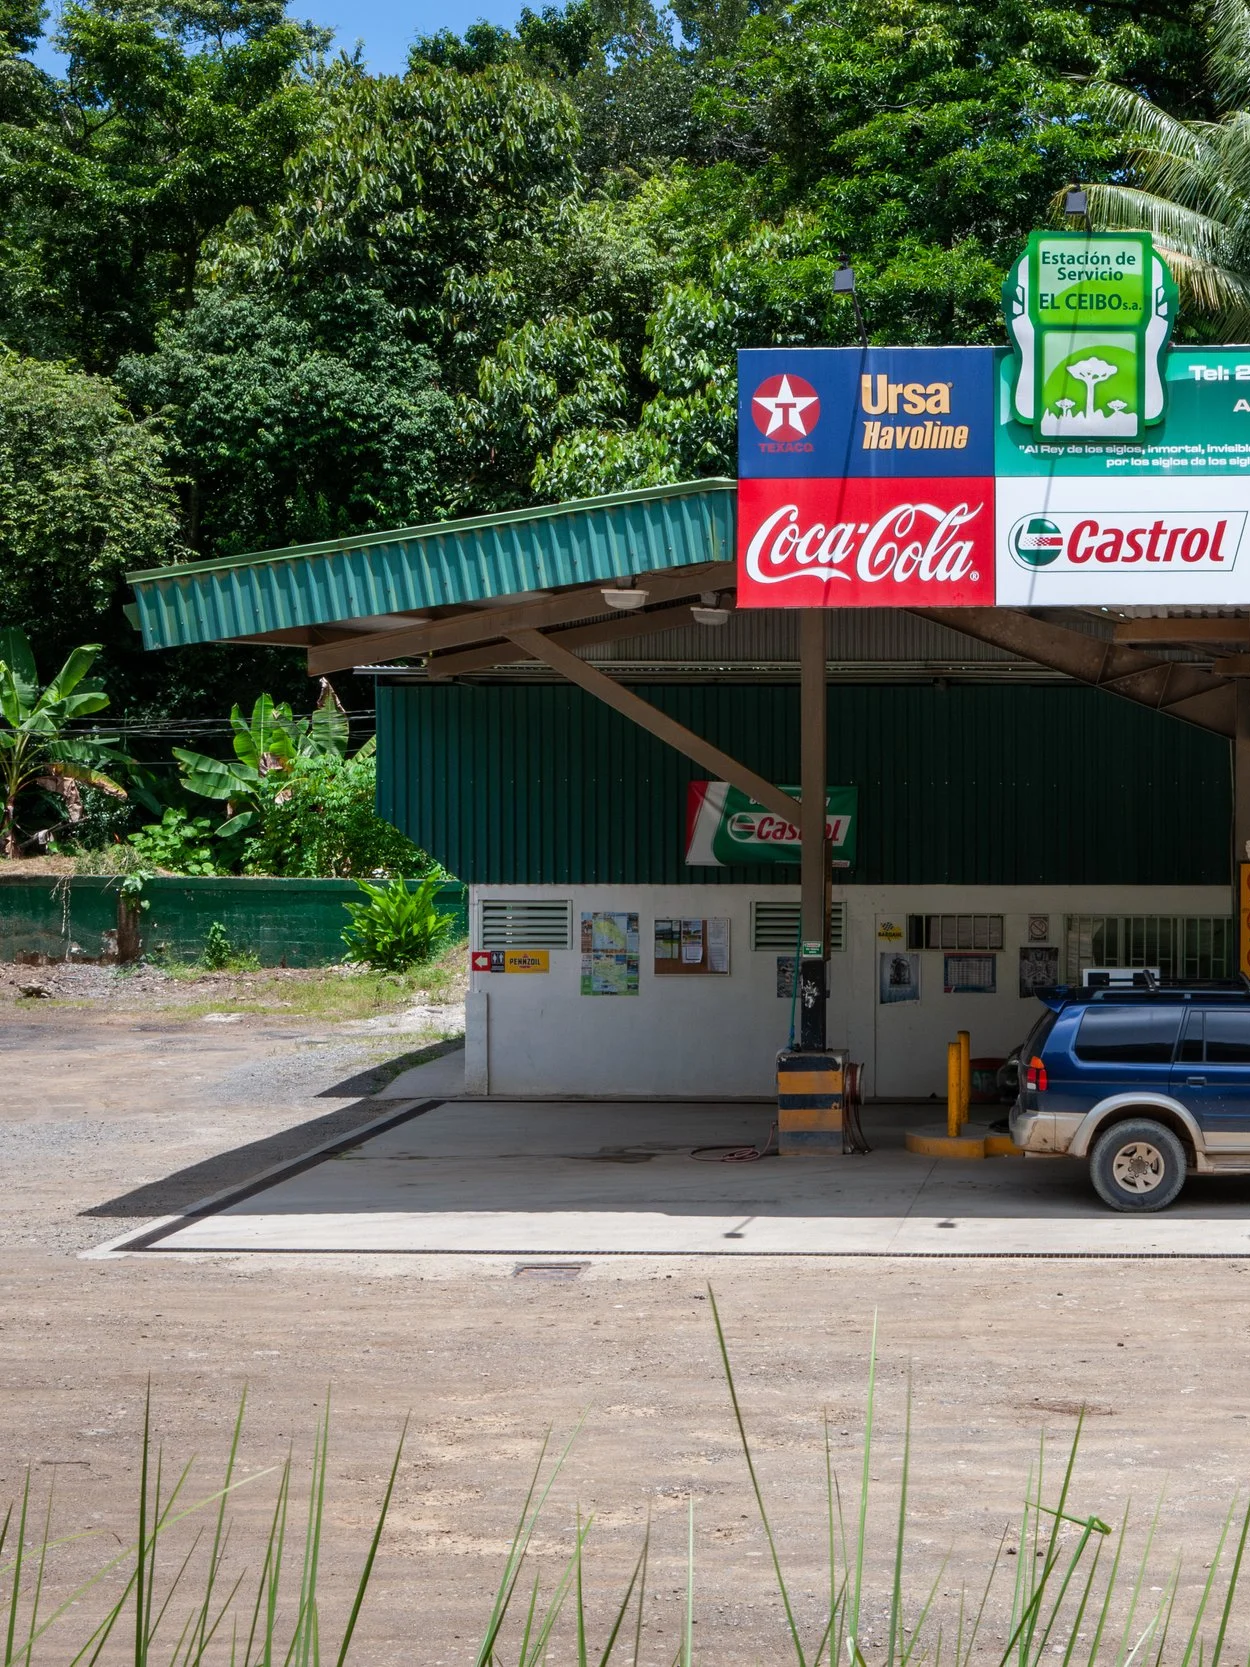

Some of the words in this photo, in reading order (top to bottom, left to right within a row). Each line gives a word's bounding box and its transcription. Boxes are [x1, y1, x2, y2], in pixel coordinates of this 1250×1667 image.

[1041, 250, 1111, 266] Estación
[1115, 251, 1136, 266] de
[1057, 266, 1124, 281] Servicio
[1039, 293, 1060, 310] EL
[1064, 292, 1122, 311] CEIBO
[1189, 365, 1230, 381] Tel:
[861, 373, 951, 416] Ursa
[862, 421, 970, 450] Havoline
[758, 442, 814, 453] TEXACO
[1041, 444, 1064, 456] Rey
[1067, 444, 1082, 454] de
[1085, 444, 1104, 454] los
[1105, 444, 1146, 456] siglos,
[1148, 444, 1205, 455] inmortal,
[1107, 458, 1129, 468] por
[1131, 457, 1149, 466] los
[1151, 457, 1188, 468] siglos
[1191, 457, 1206, 466] de
[1208, 457, 1227, 466] los
[745, 501, 985, 585] Coca-Cola
[1065, 518, 1228, 564] Castrol
[509, 958, 541, 966] PENNZOIL
